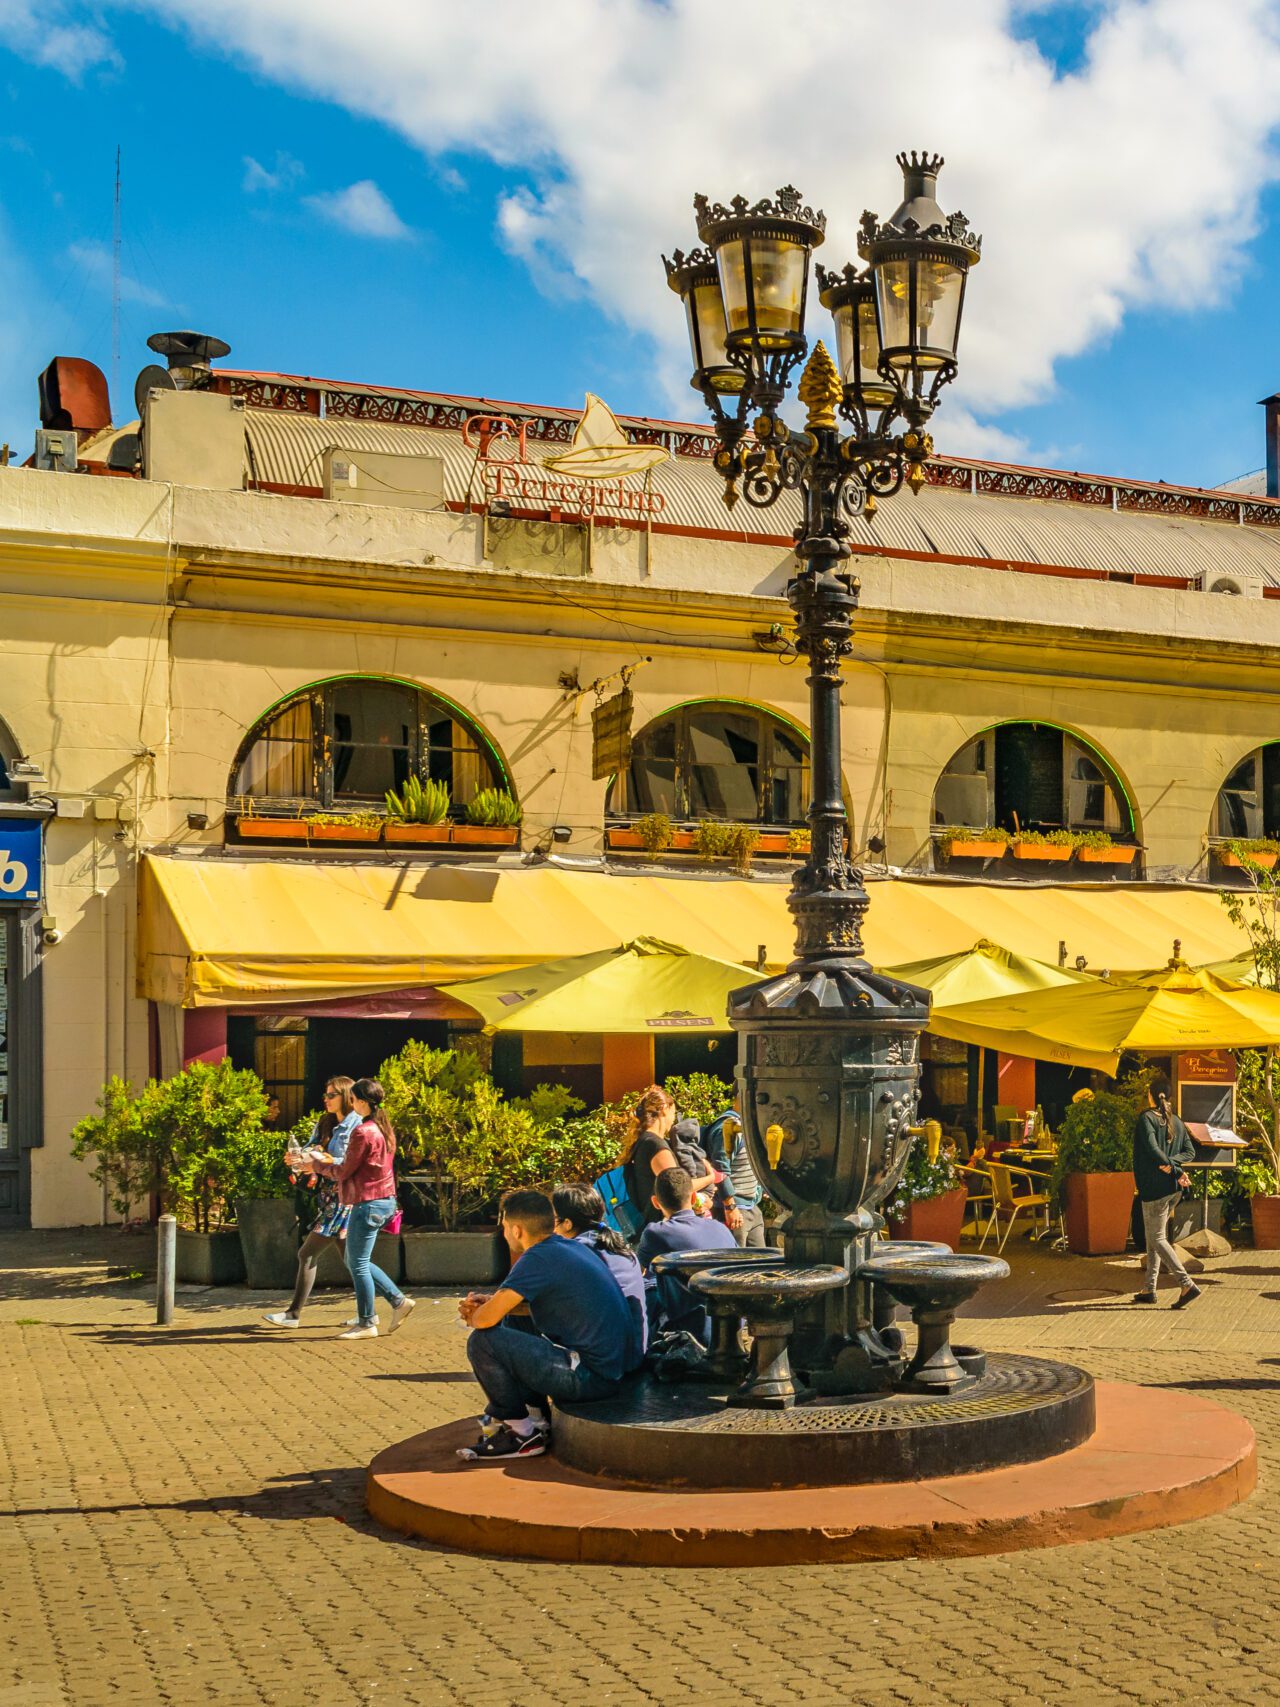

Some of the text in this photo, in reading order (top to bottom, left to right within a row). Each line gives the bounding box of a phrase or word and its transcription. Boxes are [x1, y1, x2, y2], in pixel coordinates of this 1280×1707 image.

[462, 414, 538, 464] El
[480, 463, 666, 519] Peregrino
[648, 1018, 710, 1026] PILSEN
[1186, 1057, 1200, 1066] El
[1190, 1066, 1228, 1076] Peregrino
